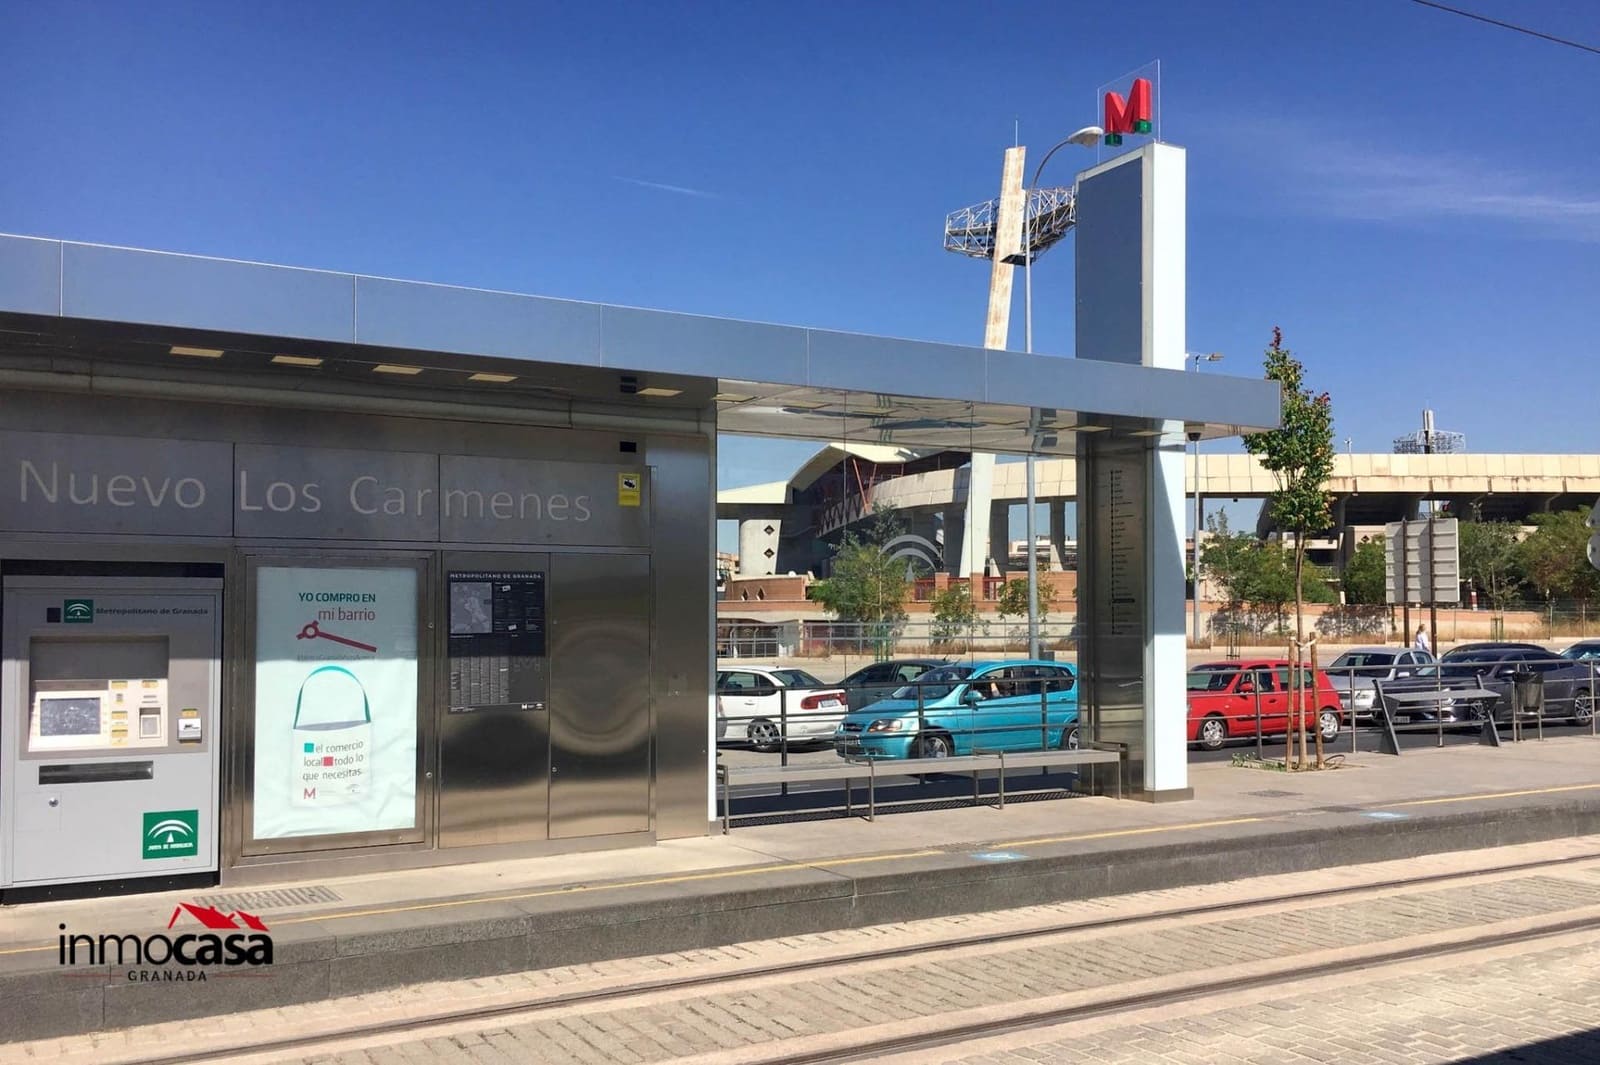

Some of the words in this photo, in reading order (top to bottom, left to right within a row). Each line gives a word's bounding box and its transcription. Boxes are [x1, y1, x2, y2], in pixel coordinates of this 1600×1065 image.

[1104, 78, 1151, 146] M
[18, 459, 206, 509] Nuevo
[239, 470, 322, 513] Los
[350, 476, 592, 522] Carmenes
[299, 592, 314, 602] YO
[315, 592, 360, 602] COMPRO
[362, 593, 376, 603] EN
[96, 607, 157, 616] Metropolitano
[159, 607, 170, 615] de
[172, 607, 208, 615] Granada
[318, 607, 335, 621] mi
[337, 606, 376, 621] barrio
[315, 744, 323, 753] el
[325, 739, 364, 753] comercio
[303, 756, 323, 767] local
[334, 755, 354, 766] todo
[355, 752, 364, 762] lo
[302, 772, 320, 782] que
[322, 768, 361, 780] necesitas
[303, 787, 316, 800] M
